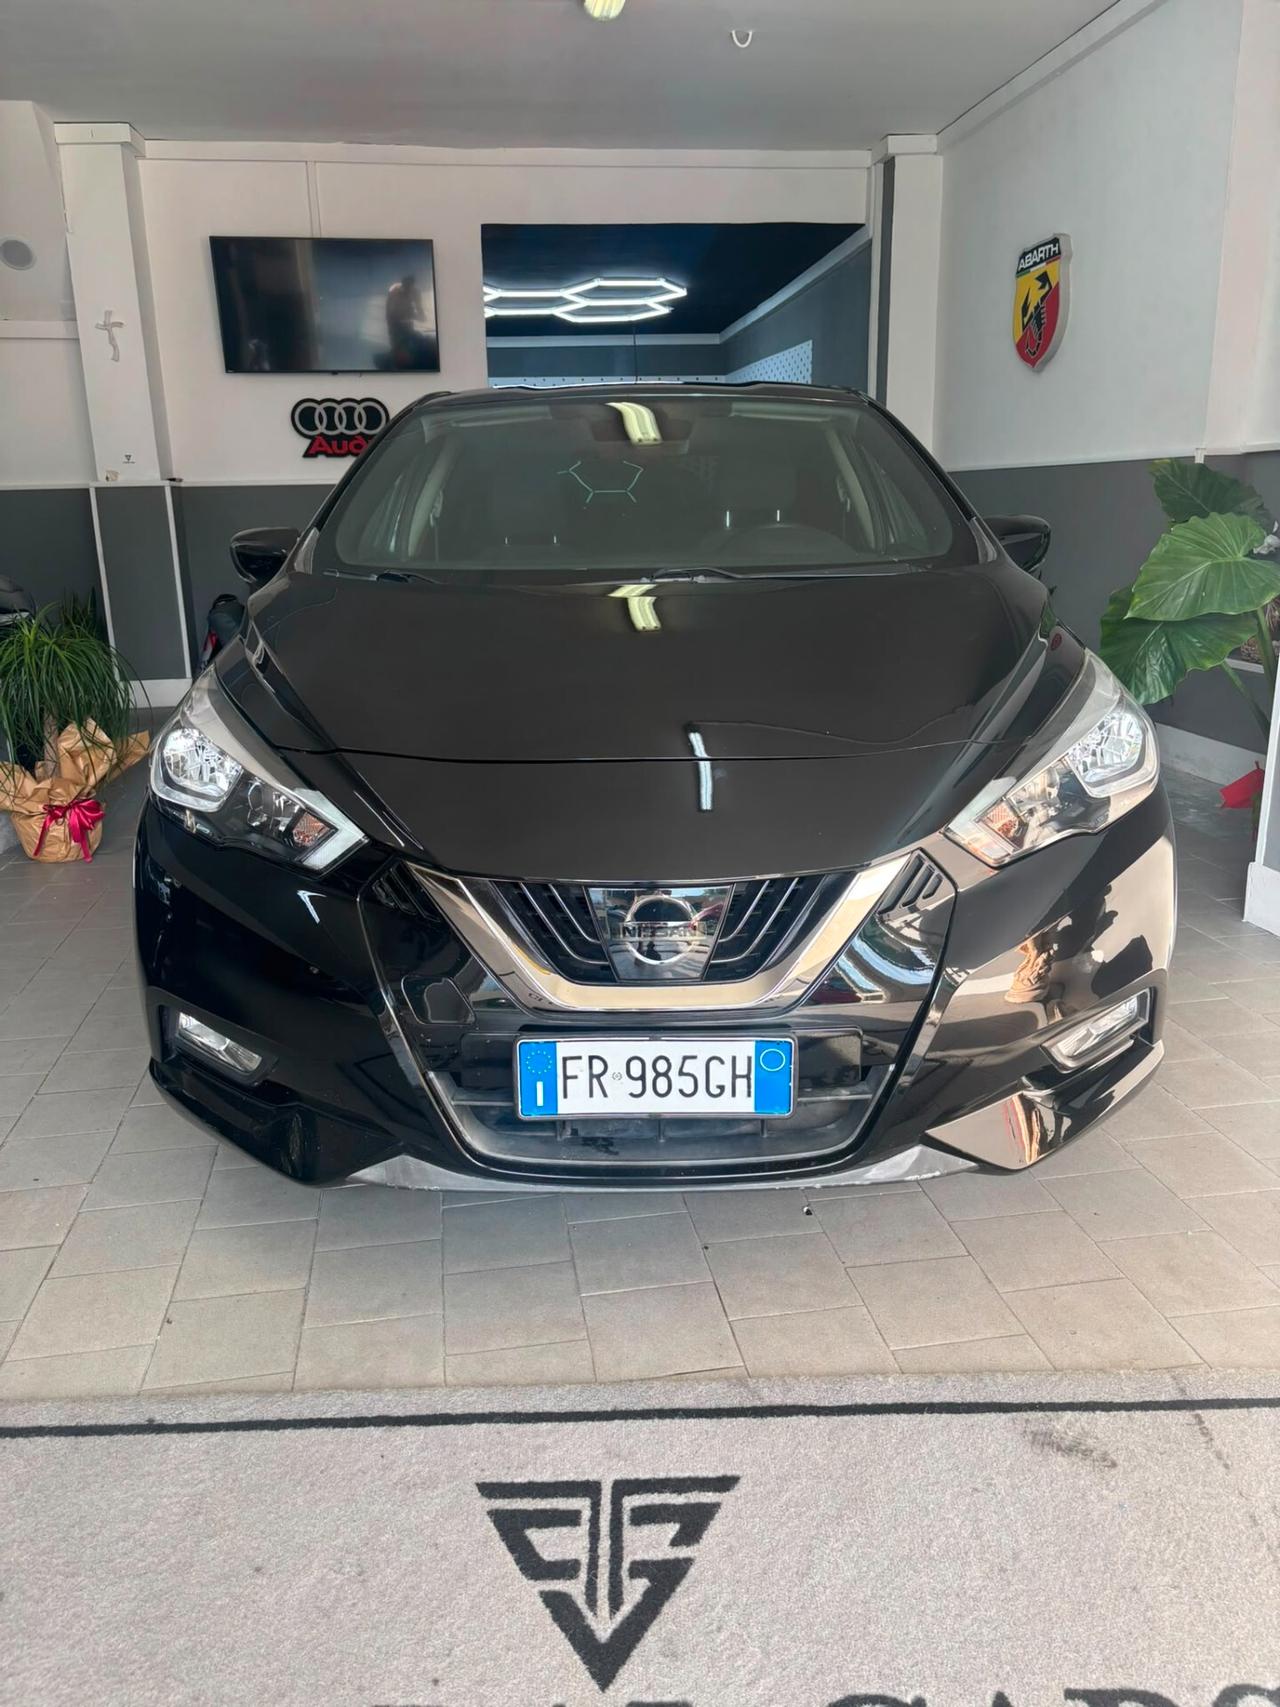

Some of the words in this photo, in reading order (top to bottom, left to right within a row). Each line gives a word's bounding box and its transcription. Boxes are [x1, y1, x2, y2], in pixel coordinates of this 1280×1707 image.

[1018, 243, 1059, 271] ABARTH
[622, 924, 698, 938] NISSAN
[562, 1055, 609, 1099] FR
[625, 1055, 752, 1098] 985GH
